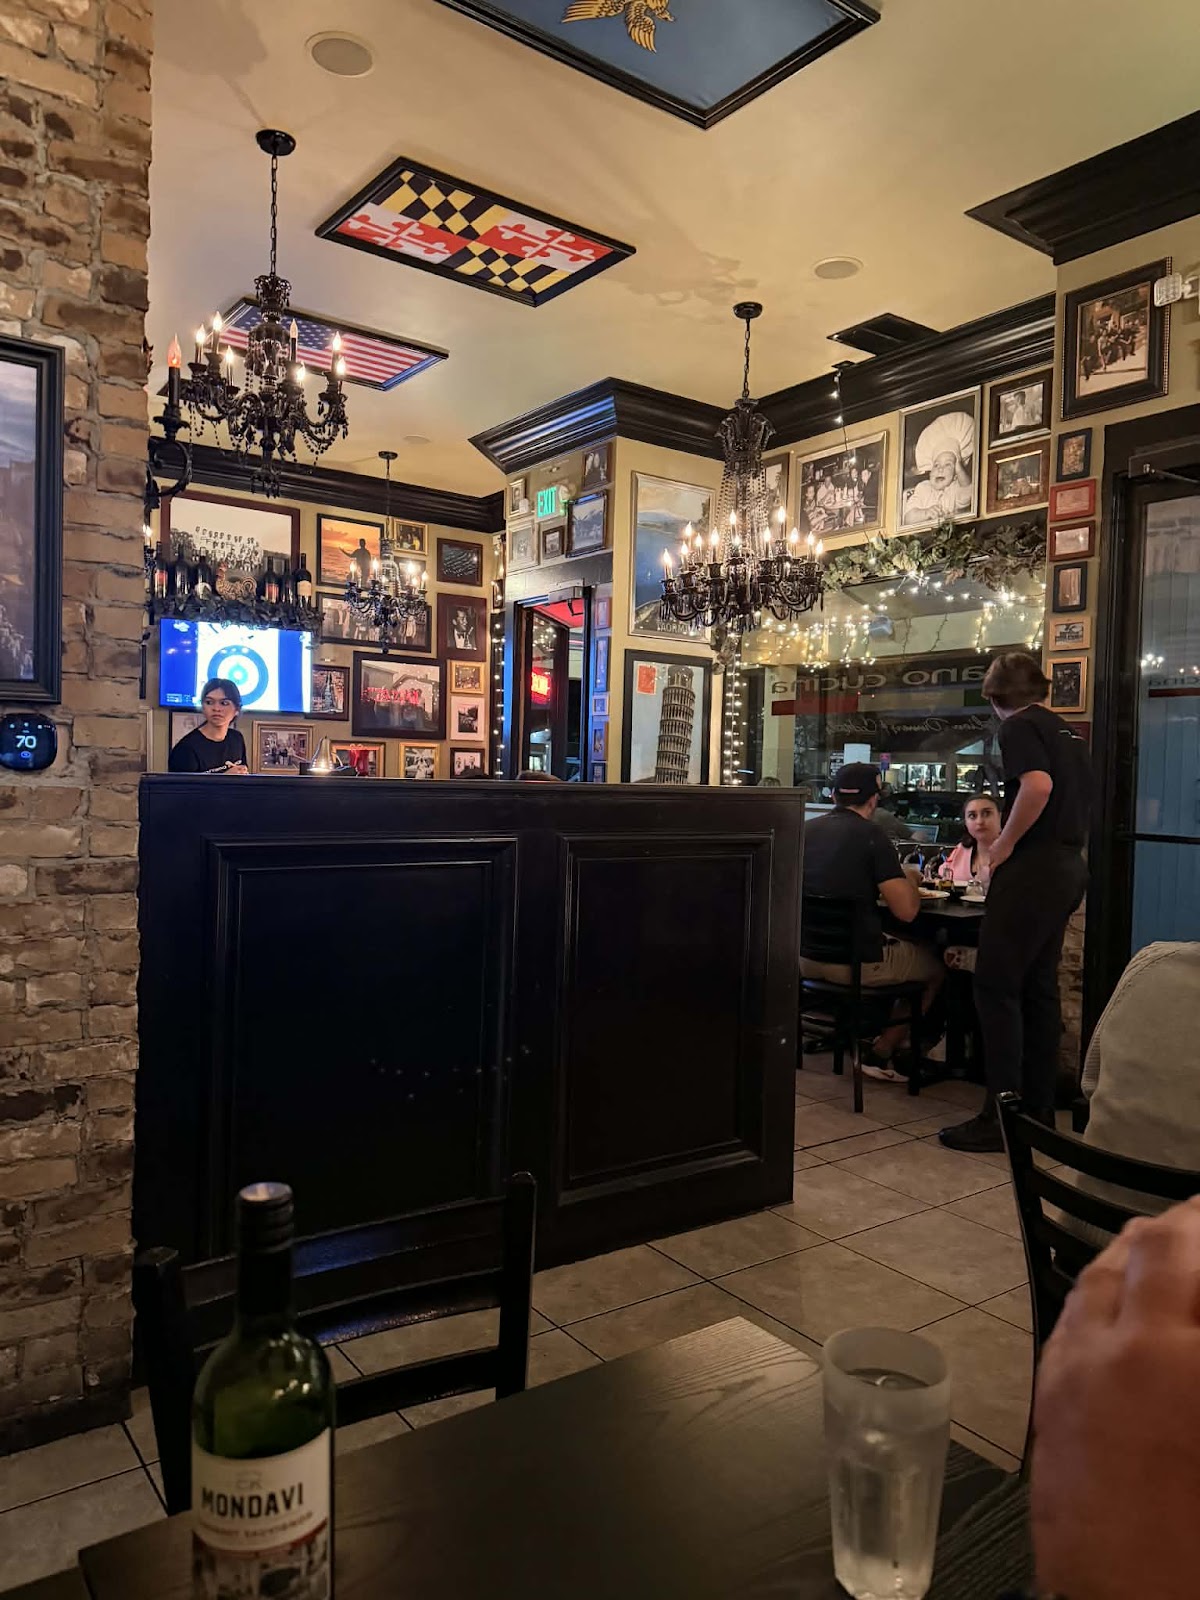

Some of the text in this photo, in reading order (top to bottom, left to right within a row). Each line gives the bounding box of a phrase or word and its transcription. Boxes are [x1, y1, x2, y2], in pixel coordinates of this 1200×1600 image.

[537, 486, 557, 518] EXIT
[15, 735, 37, 749] 70
[202, 1481, 304, 1519] MONDAVI
